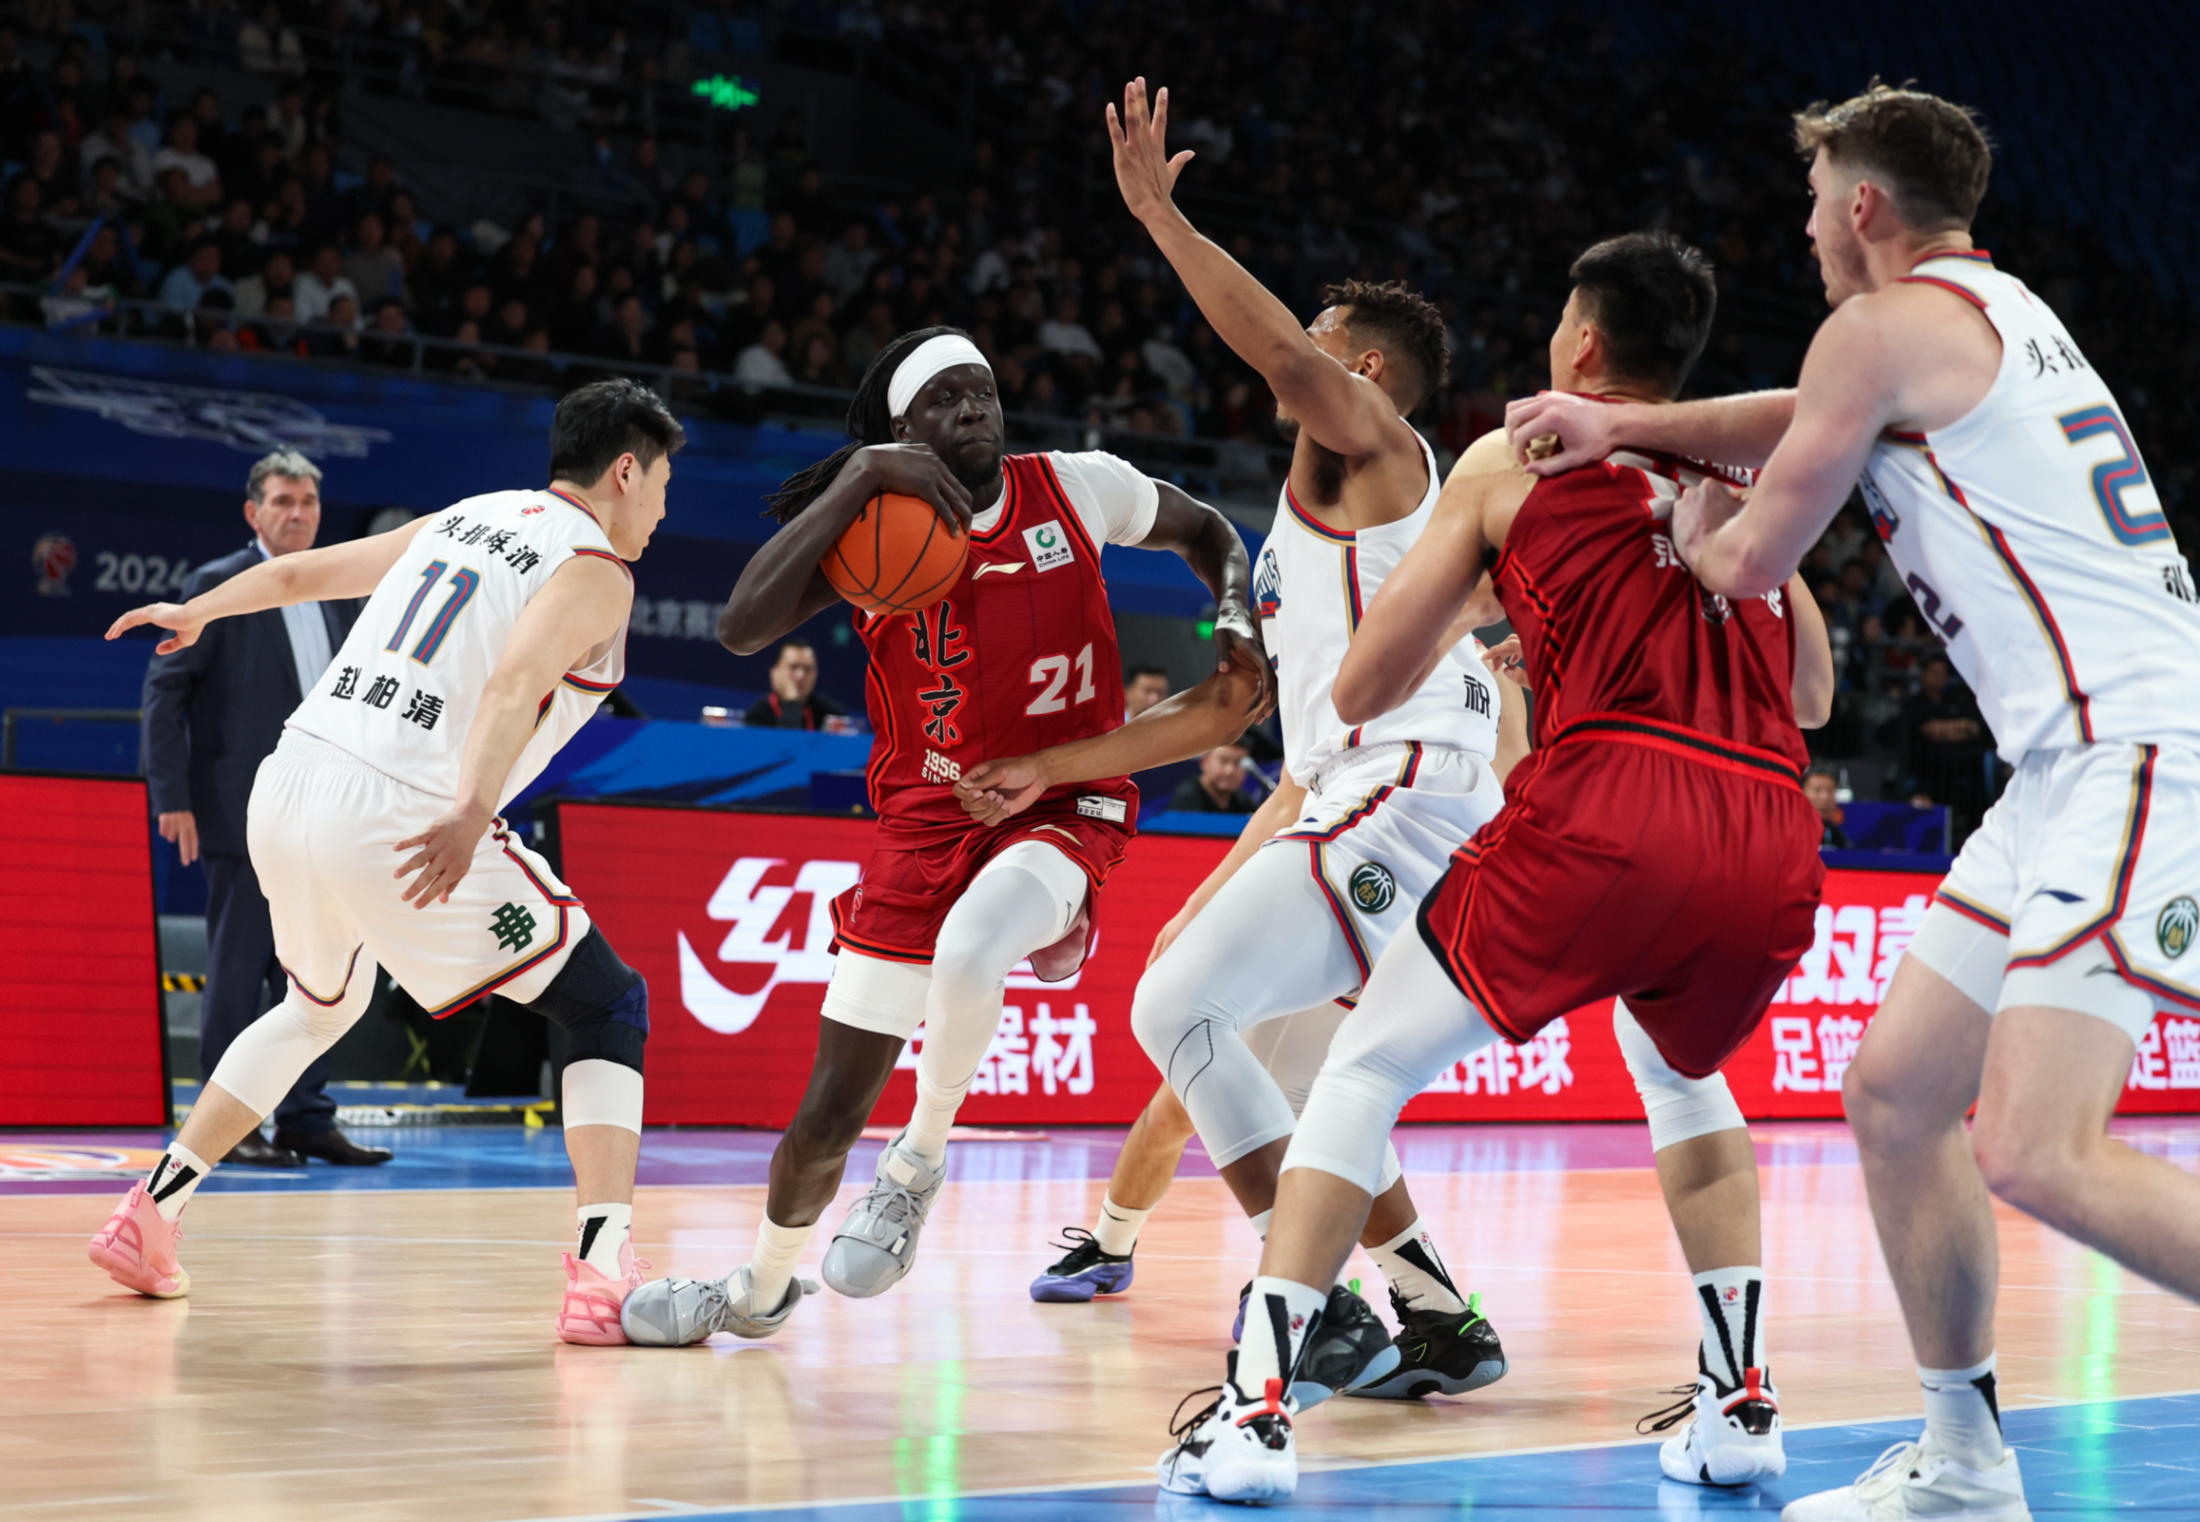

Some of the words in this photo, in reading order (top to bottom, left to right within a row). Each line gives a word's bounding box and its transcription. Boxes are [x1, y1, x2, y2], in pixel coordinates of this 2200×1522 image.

[2054, 401, 2173, 547] 2
[383, 558, 482, 668] 11
[330, 665, 445, 731] 赵柏清
[909, 600, 970, 744] 北京
[1024, 640, 1096, 717] 21
[921, 766, 951, 784] SIN
[924, 748, 961, 781] 1956
[1770, 1013, 1876, 1093] 足篮
